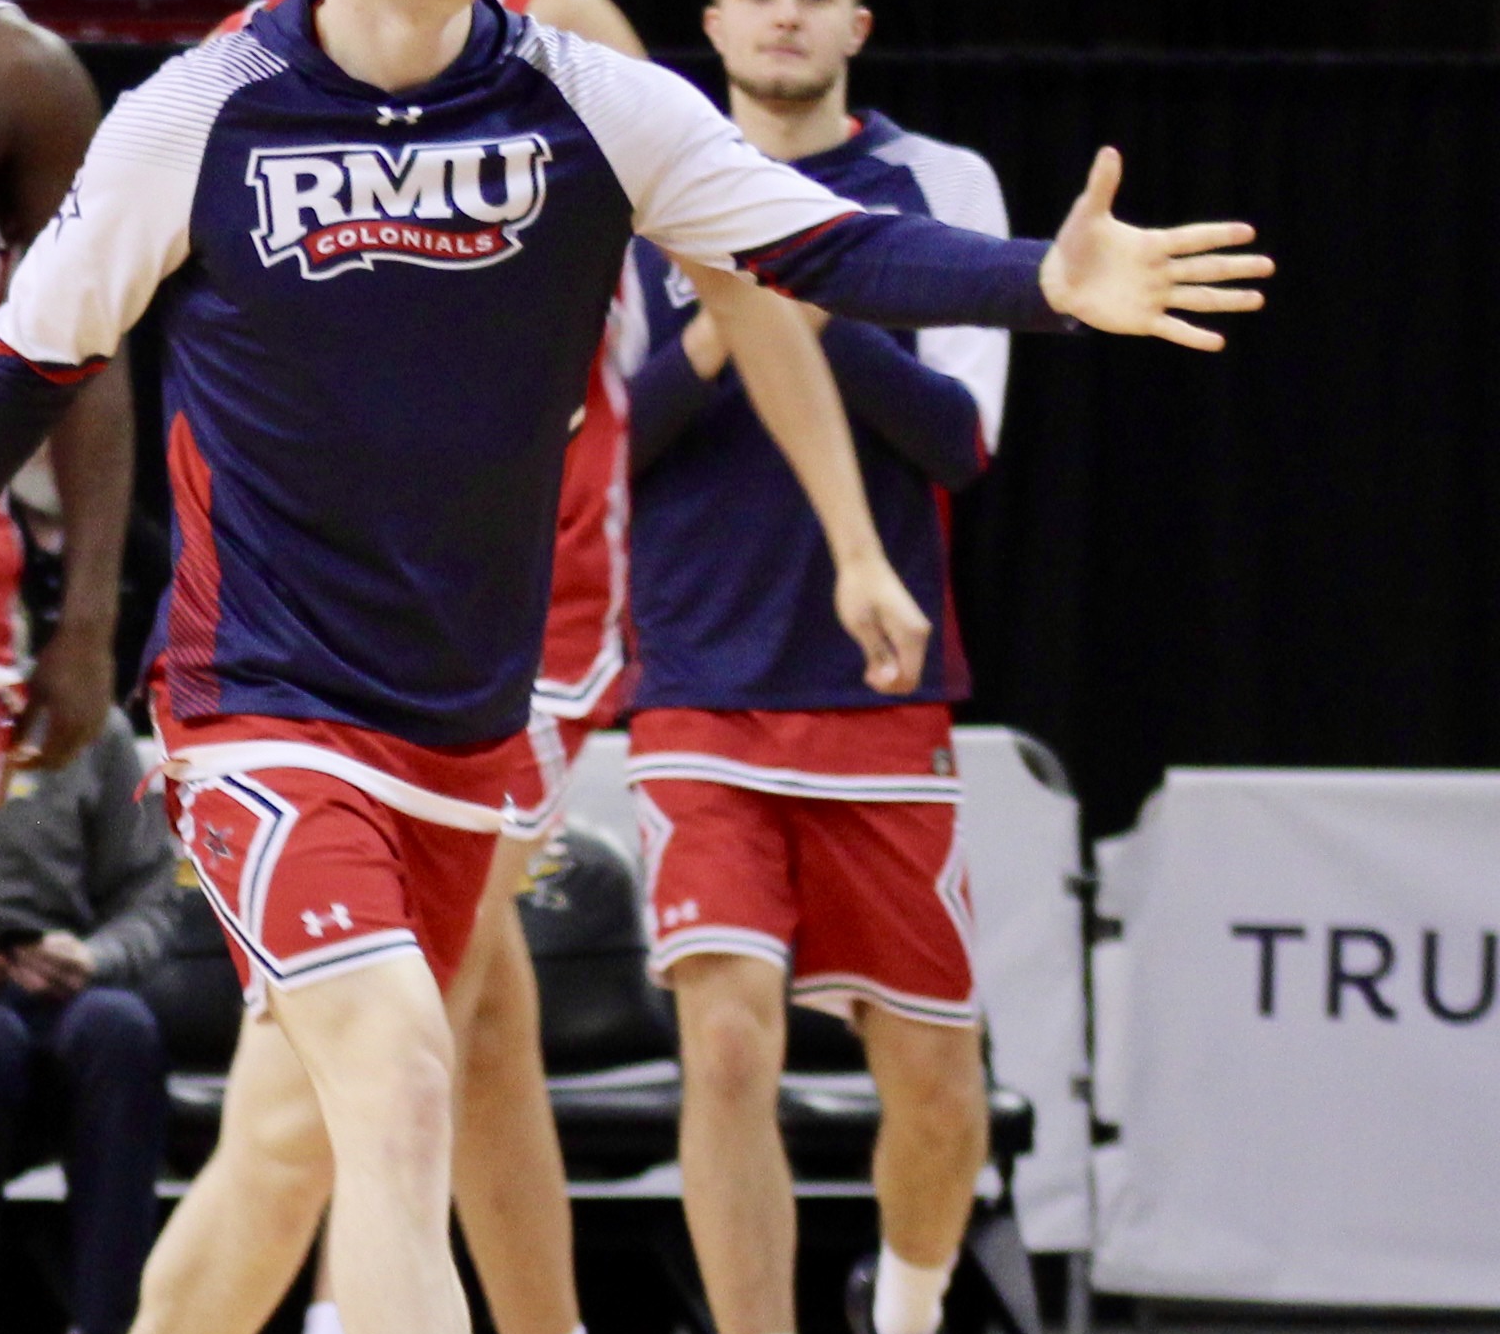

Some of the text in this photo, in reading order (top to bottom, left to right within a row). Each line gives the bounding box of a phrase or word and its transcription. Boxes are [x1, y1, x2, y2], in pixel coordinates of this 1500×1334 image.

[258, 139, 543, 250] RMU
[316, 227, 494, 255] COLONIALS
[1231, 924, 1498, 1025] TRU
